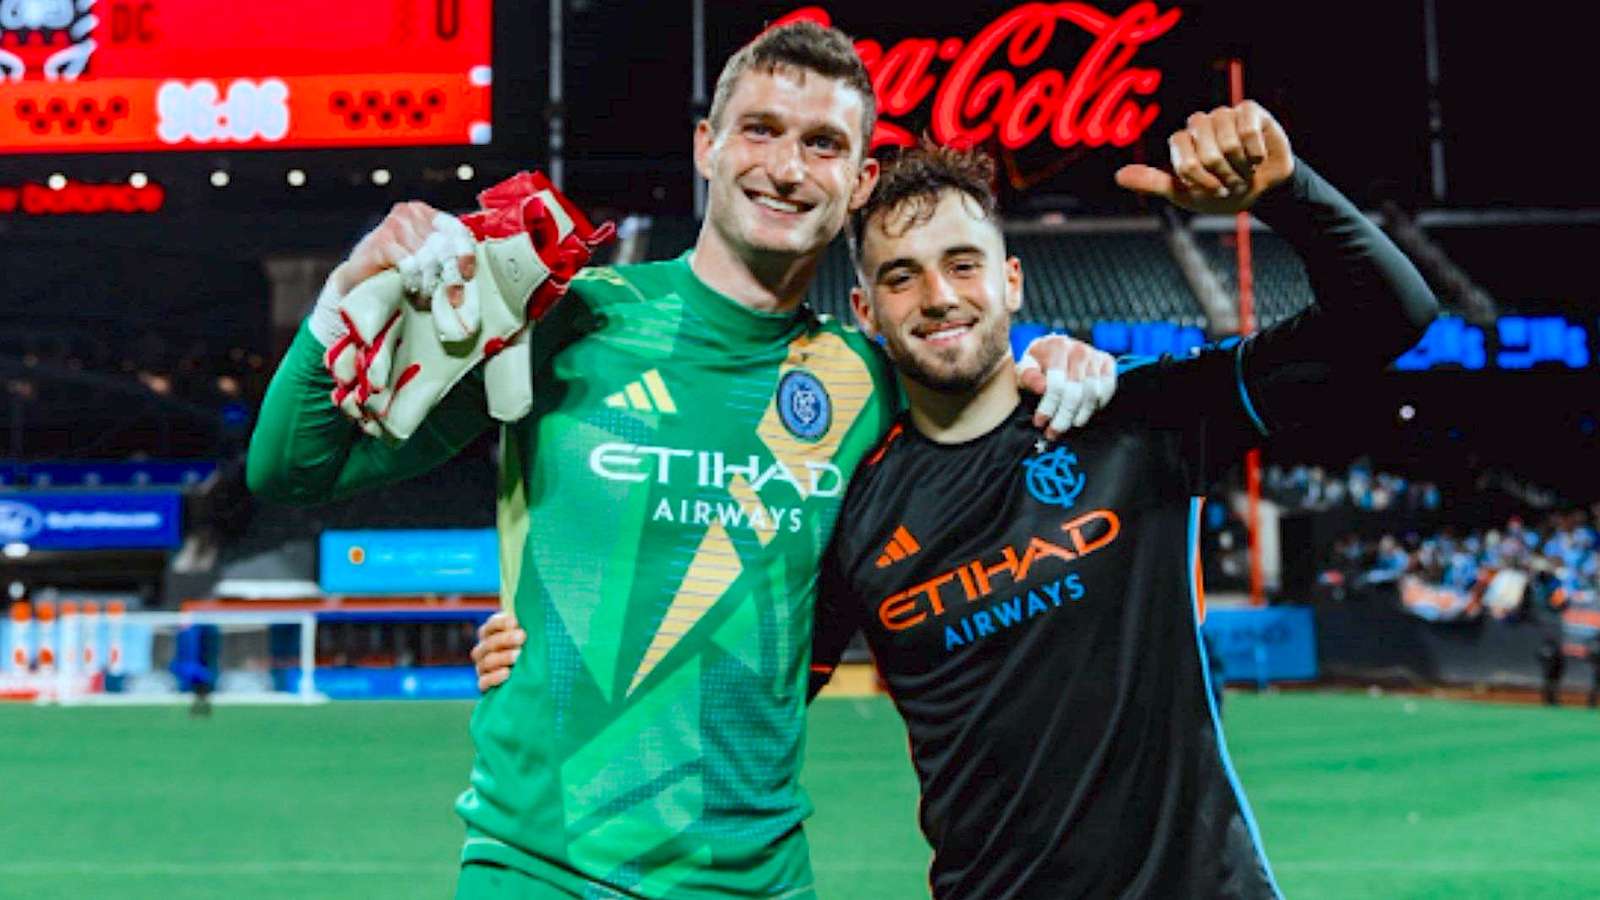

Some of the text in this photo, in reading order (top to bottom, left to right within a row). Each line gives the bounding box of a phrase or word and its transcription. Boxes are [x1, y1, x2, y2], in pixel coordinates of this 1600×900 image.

[588, 442, 843, 501] ETIHAD
[652, 497, 804, 533] AIRWAYS
[878, 509, 1121, 631] ETIHAD
[943, 572, 1086, 650] AIRWAYS
